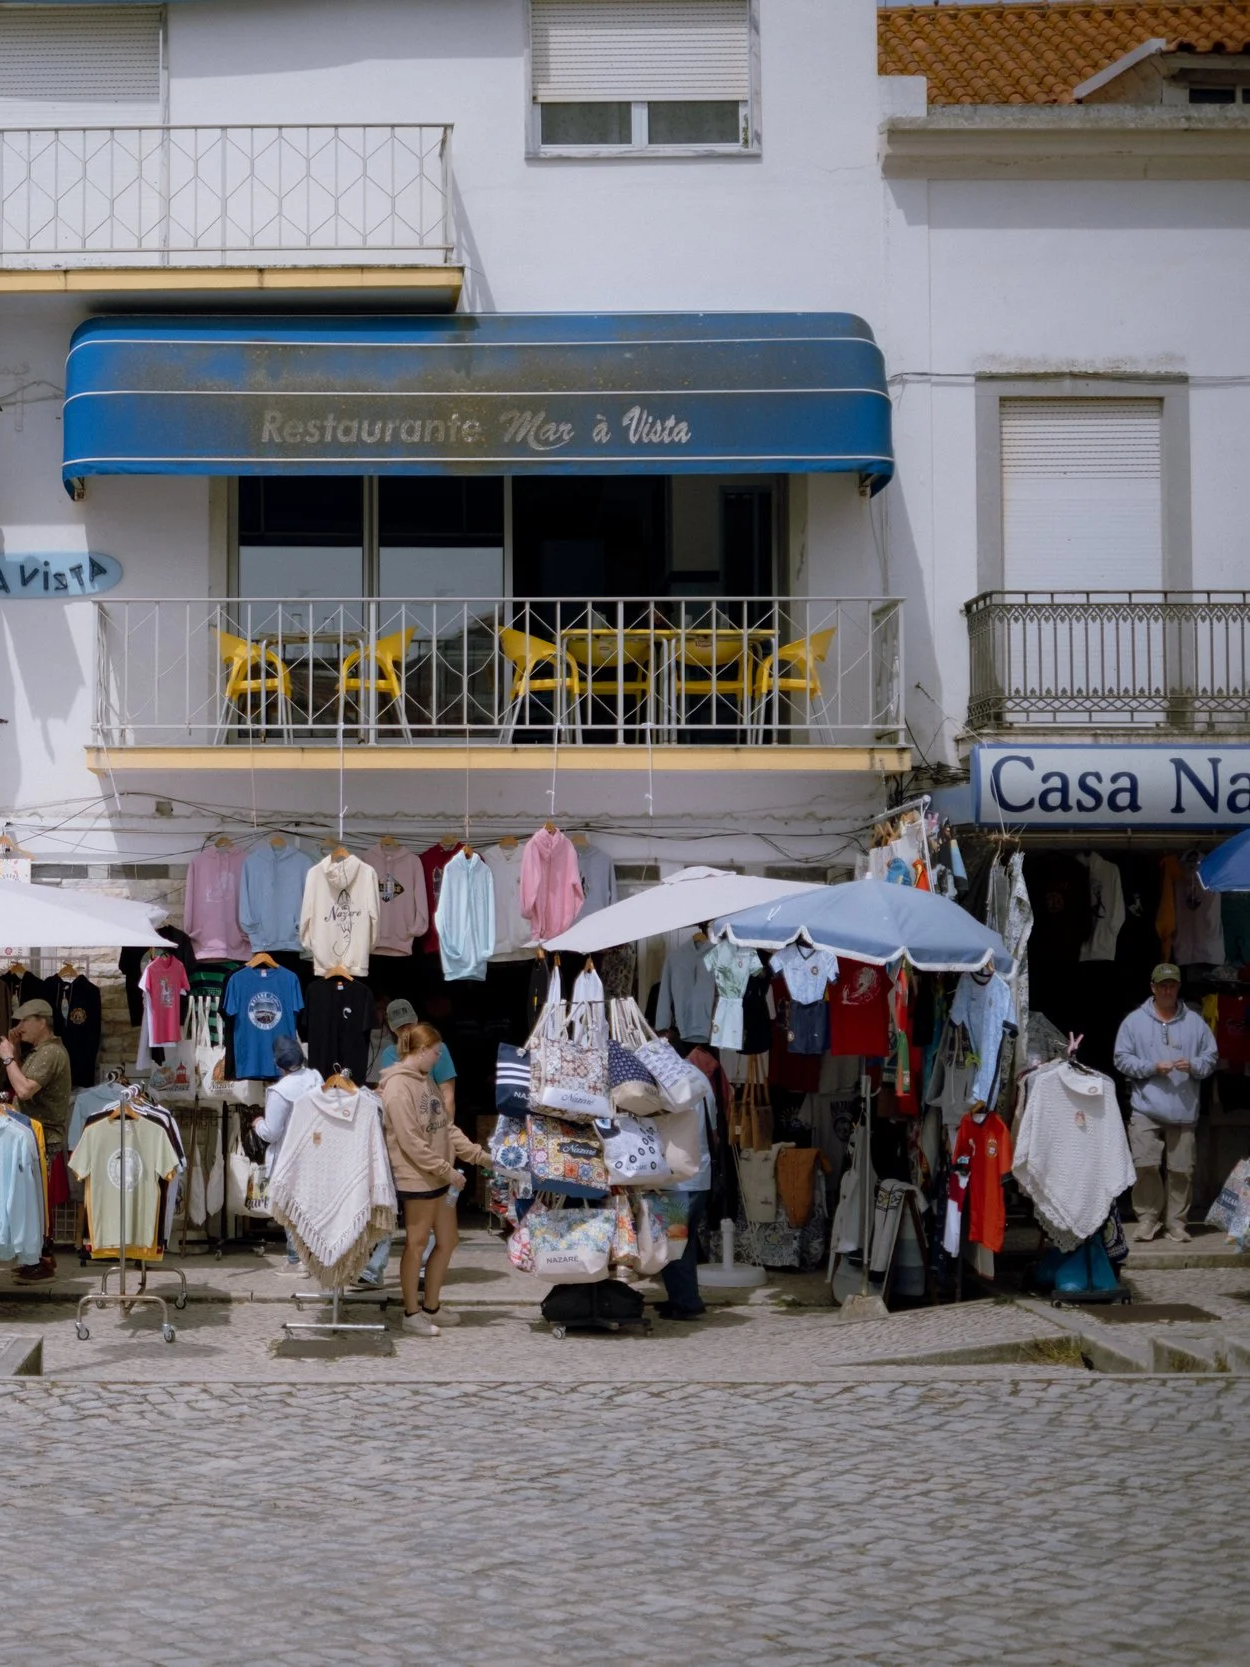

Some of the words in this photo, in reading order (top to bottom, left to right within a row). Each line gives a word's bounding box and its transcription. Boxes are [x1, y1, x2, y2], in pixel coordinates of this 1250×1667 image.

[261, 409, 483, 444] Restaurante
[499, 408, 575, 451] Mar
[592, 413, 612, 444] à
[622, 405, 692, 445] Vista
[989, 755, 1143, 813] Casa
[513, 1091, 531, 1100] NA
